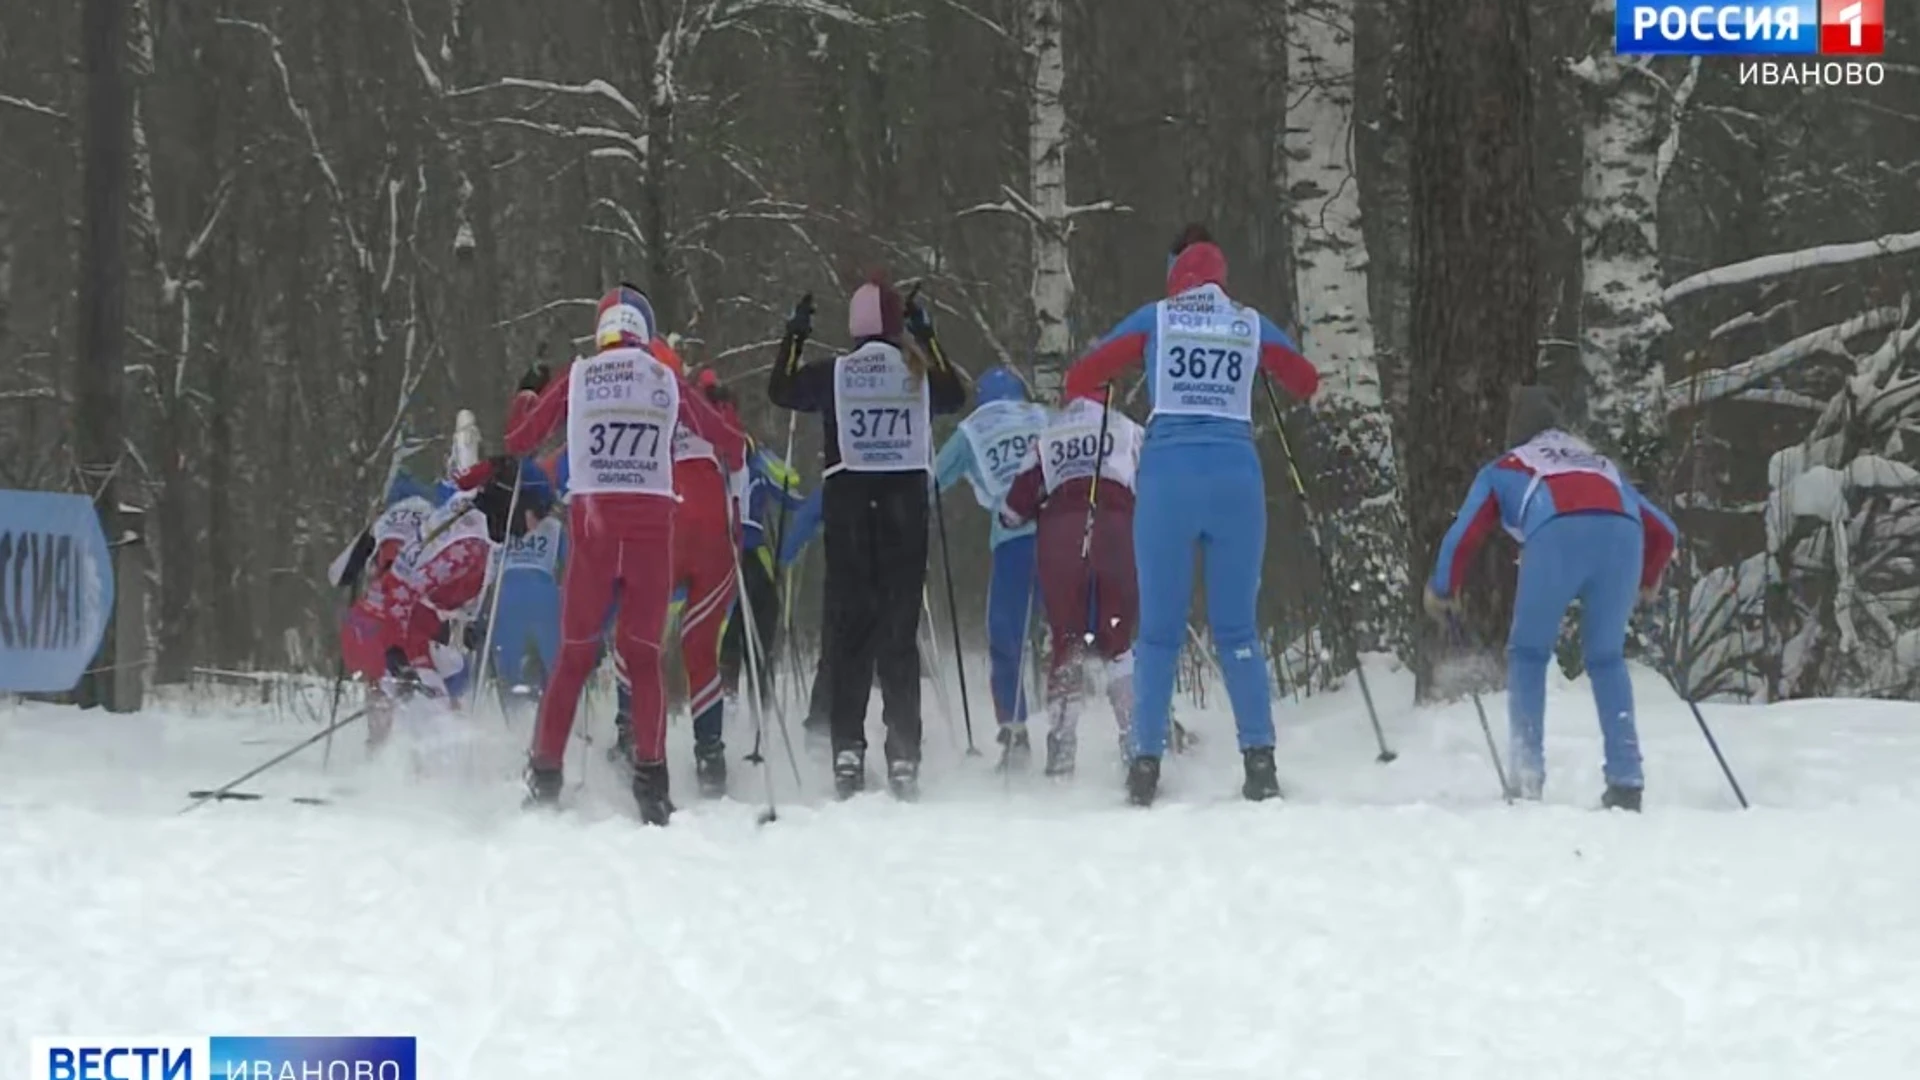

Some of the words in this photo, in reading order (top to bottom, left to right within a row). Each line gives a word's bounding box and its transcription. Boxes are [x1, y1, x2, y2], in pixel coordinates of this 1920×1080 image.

[584, 371, 634, 386] РОССИИ
[1168, 345, 1243, 382] 3678
[585, 385, 632, 401] 2021
[849, 408, 912, 438] 3771
[589, 421, 660, 458] 3777
[1051, 432, 1115, 467] 3800
[597, 473, 646, 484] ОБЛАСТЬ
